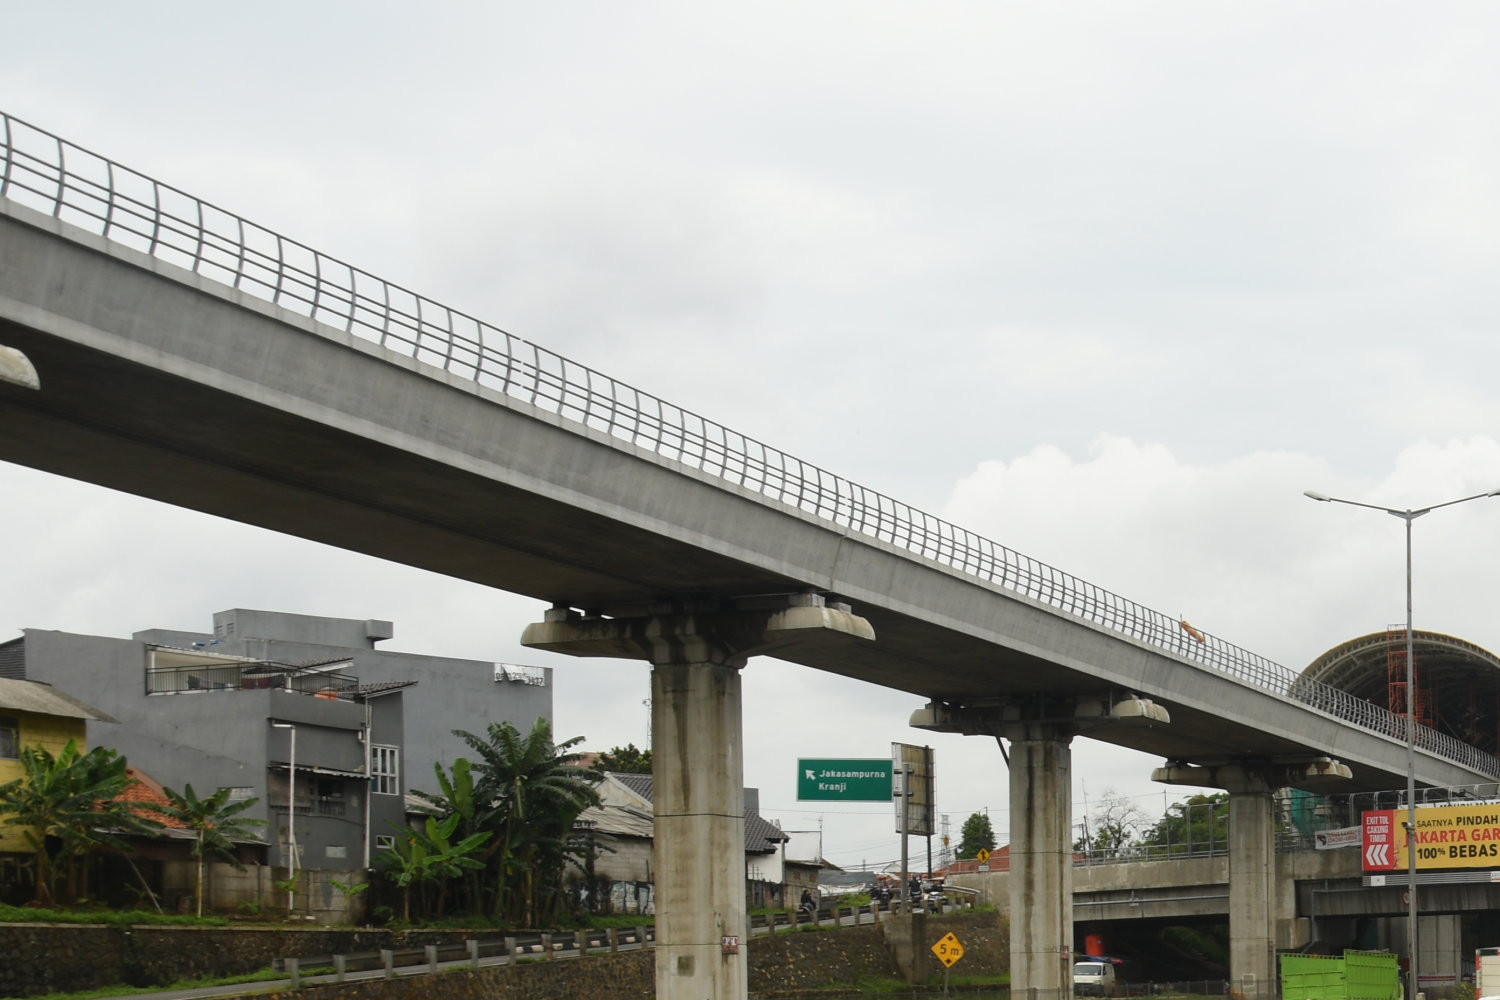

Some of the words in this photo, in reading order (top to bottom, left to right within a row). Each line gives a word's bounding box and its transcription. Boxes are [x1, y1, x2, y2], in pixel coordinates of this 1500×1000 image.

[819, 769, 886, 779] Jakasampurna
[818, 782, 847, 792] Kranji
[1366, 816, 1378, 825] EXIT
[1379, 816, 1389, 824] TOL
[1416, 819, 1453, 828] SAATNYA
[1456, 815, 1498, 826] PINDAH
[1369, 834, 1387, 843] TIMUR
[1403, 829, 1467, 847] JAKARTA
[1417, 848, 1446, 859] 100%
[1449, 844, 1498, 858] BEBAS
[940, 944, 947, 954] 5
